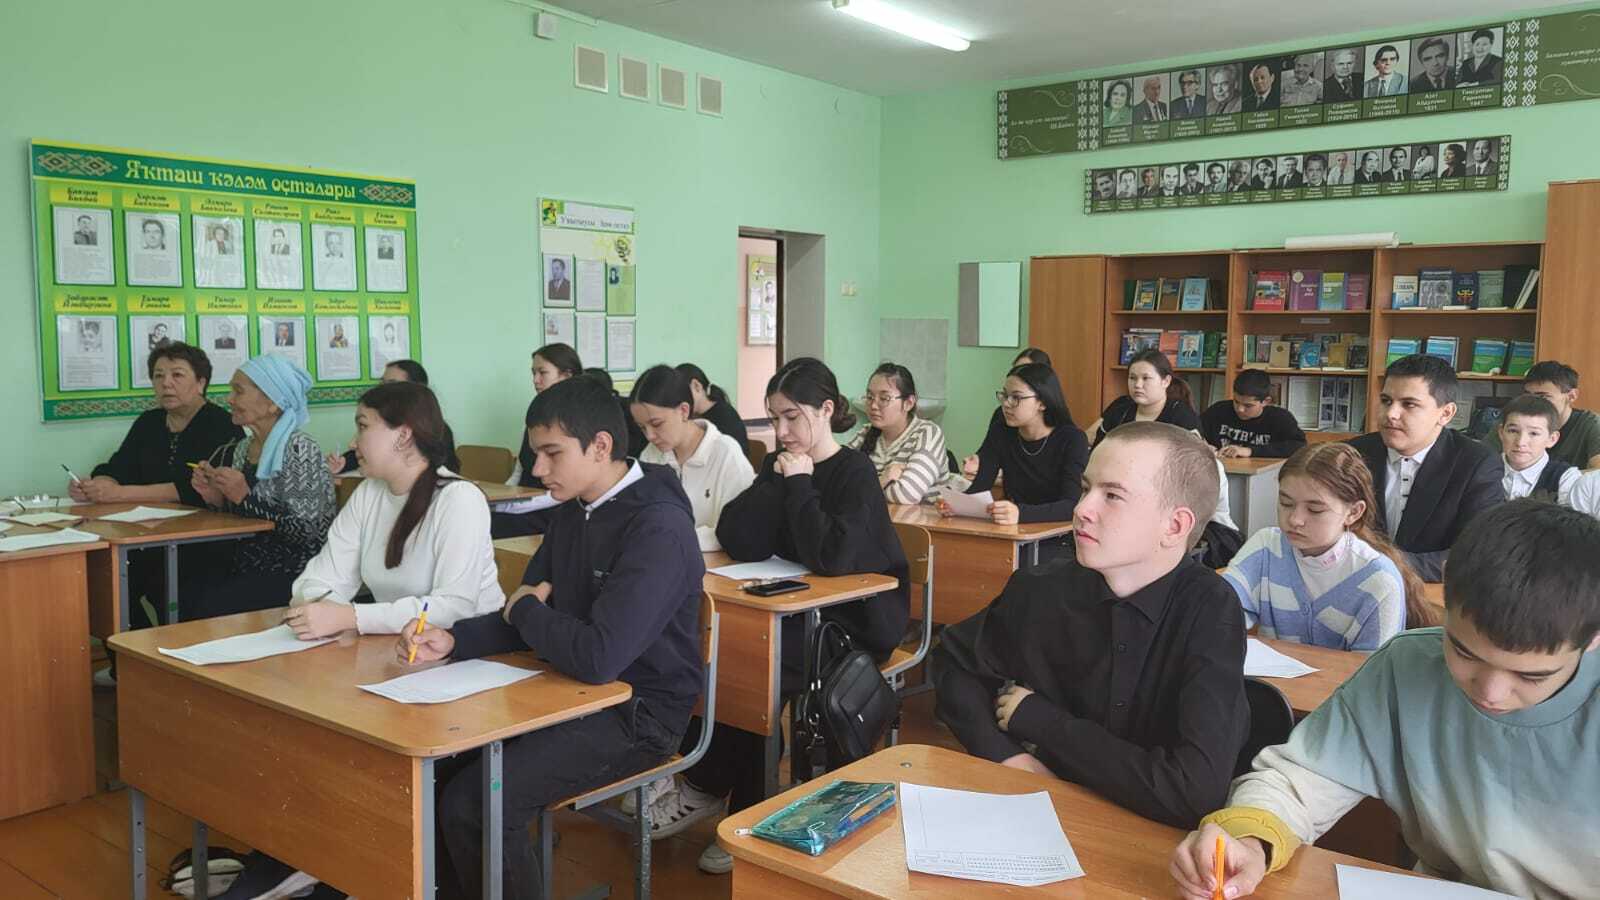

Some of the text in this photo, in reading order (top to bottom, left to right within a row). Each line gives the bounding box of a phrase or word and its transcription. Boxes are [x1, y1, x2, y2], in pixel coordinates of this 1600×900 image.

[125, 159, 357, 201] Яҡташ ҡәләм оҫталары
